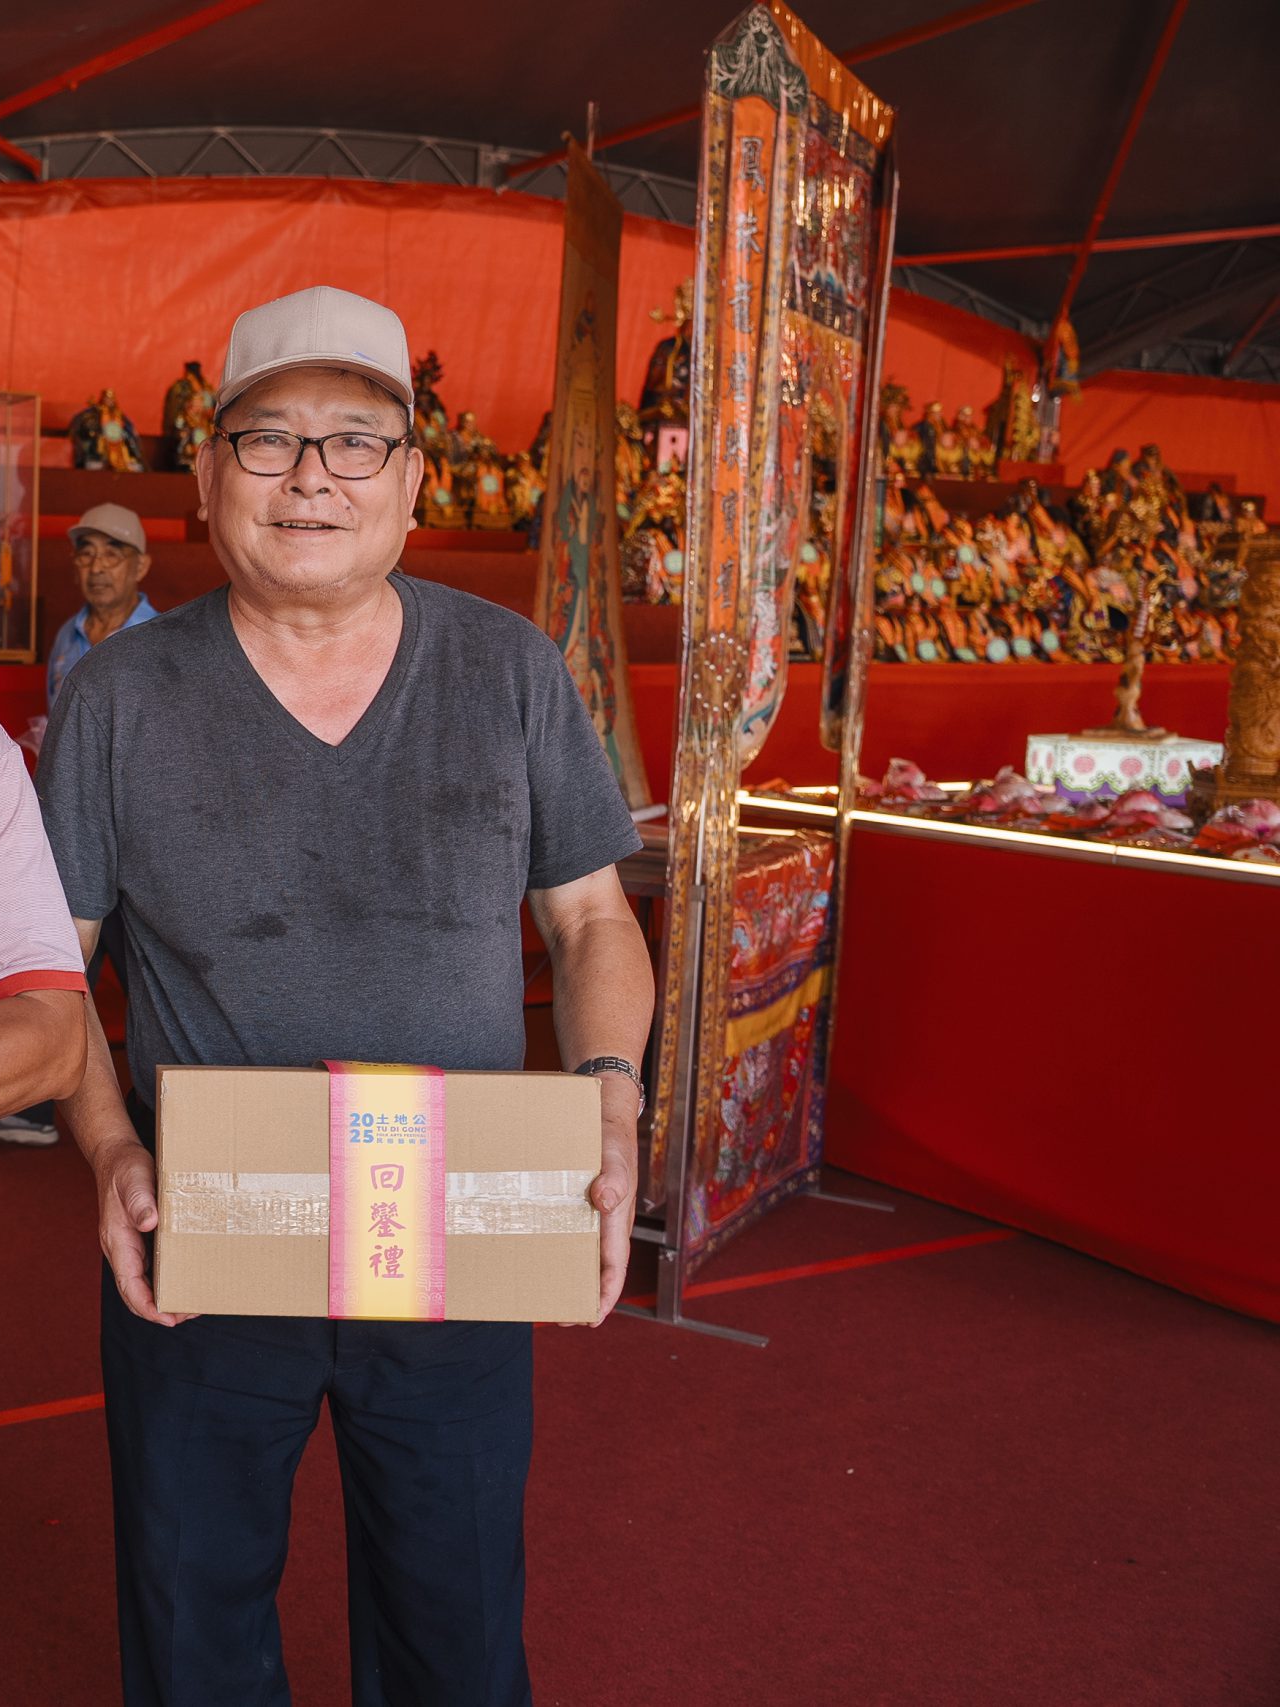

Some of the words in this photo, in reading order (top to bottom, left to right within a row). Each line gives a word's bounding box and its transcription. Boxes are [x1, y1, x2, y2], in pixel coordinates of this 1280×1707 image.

[350, 1112, 374, 1127] 20
[376, 1114, 426, 1125] 土地公
[350, 1129, 374, 1143] 25
[368, 1163, 406, 1278] 回鑾禮
